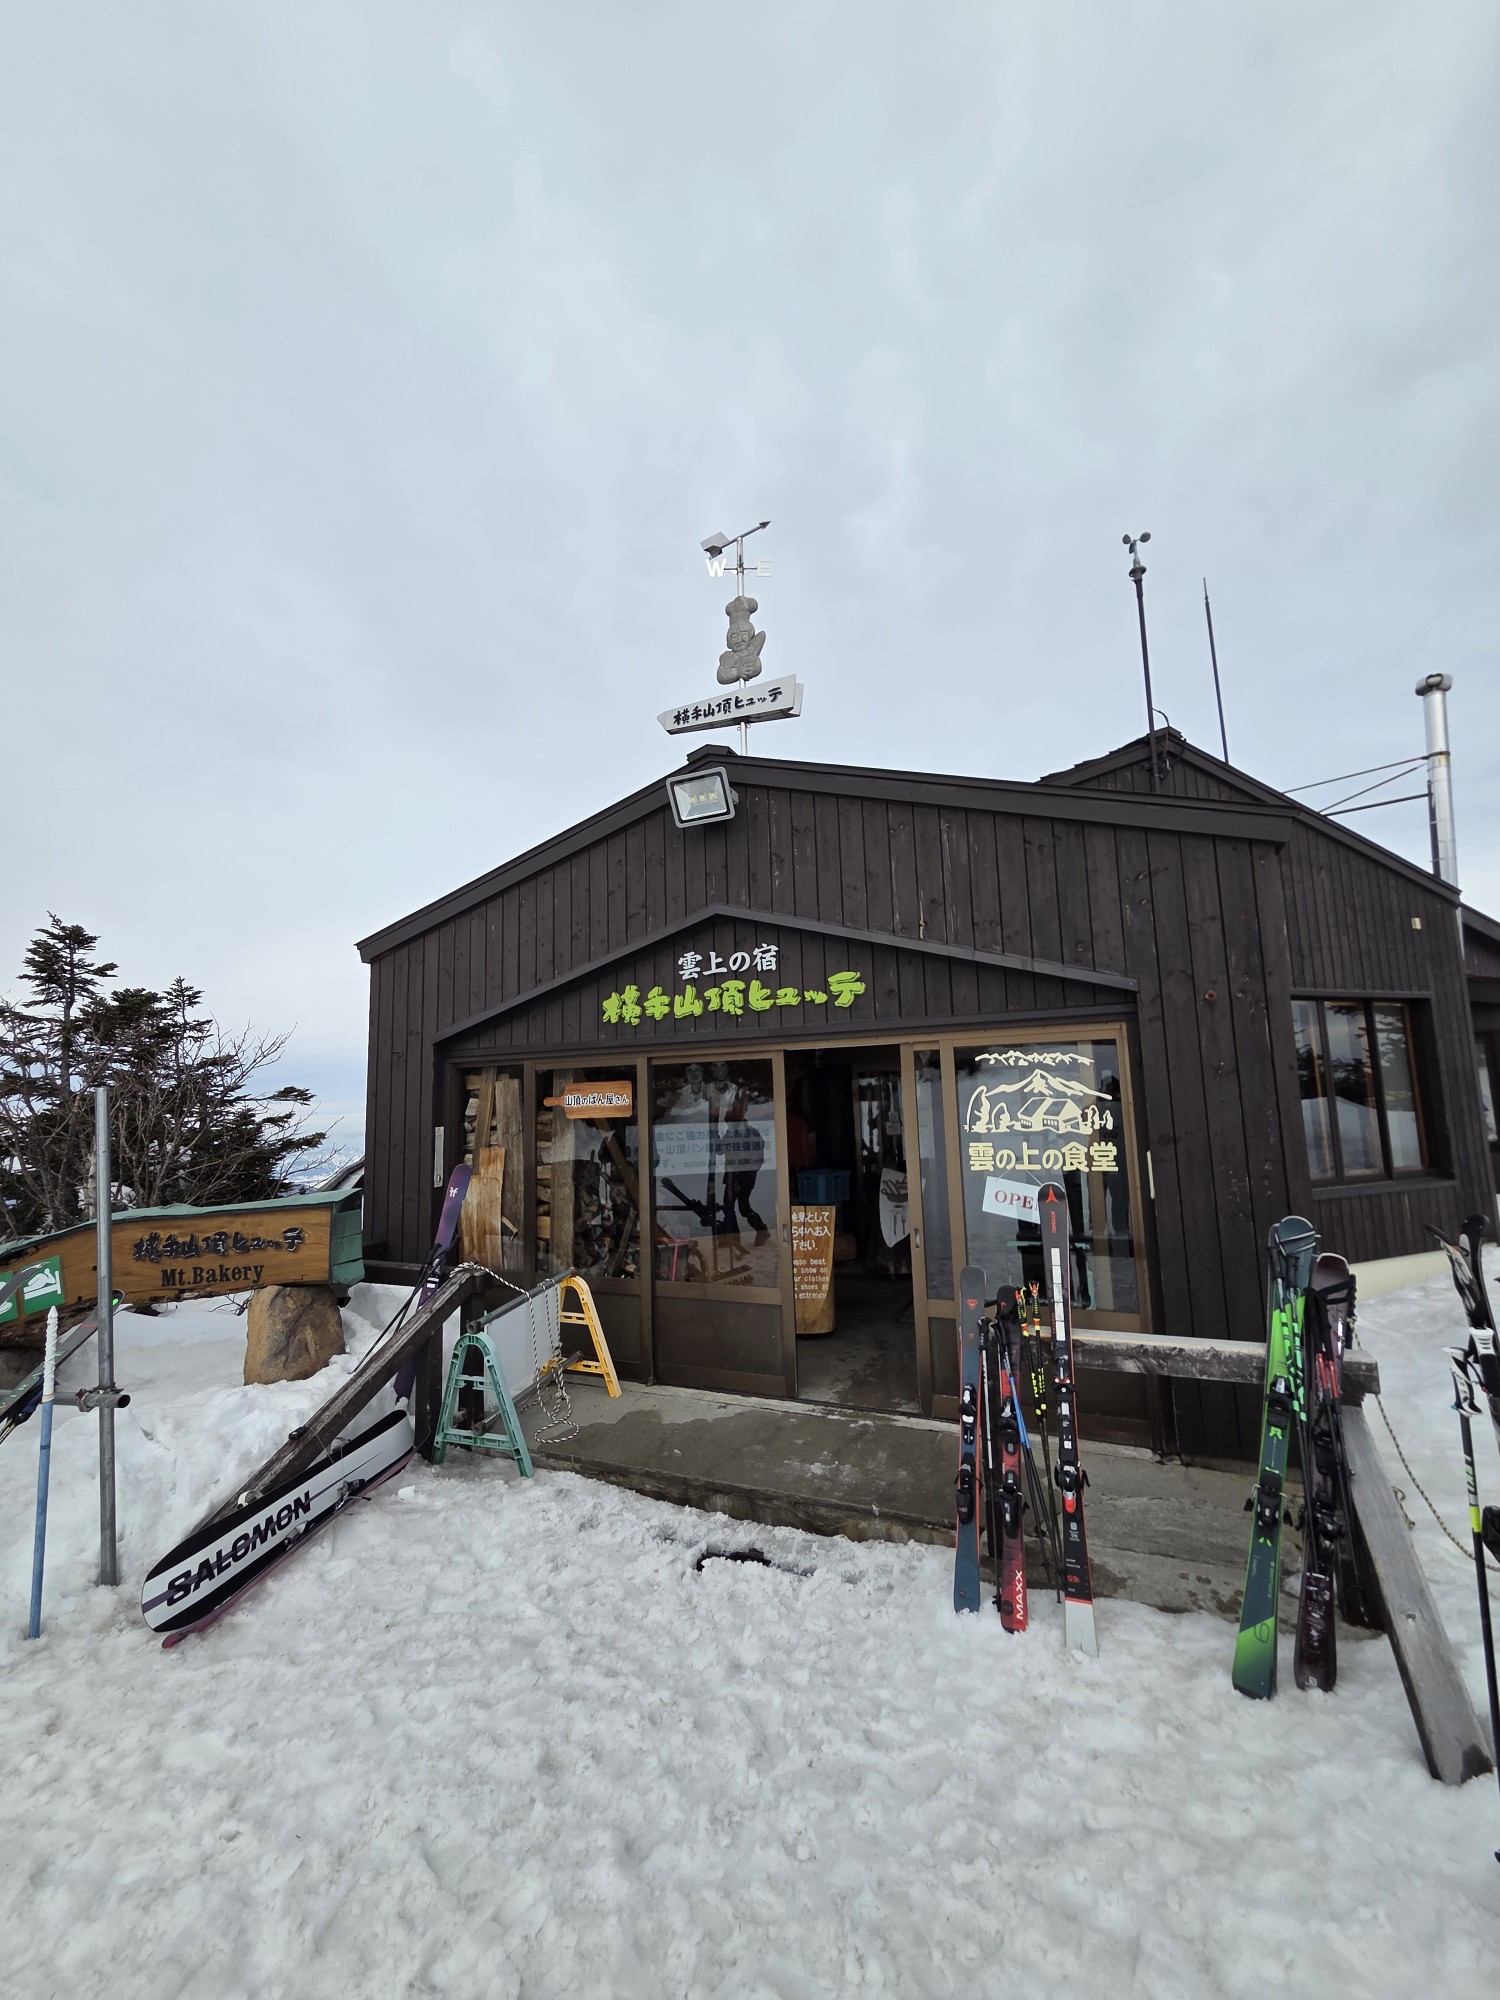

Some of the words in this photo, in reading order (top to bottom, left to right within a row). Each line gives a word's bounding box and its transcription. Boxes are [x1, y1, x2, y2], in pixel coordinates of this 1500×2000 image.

[705, 558, 727, 577] W
[757, 560, 771, 577] E
[673, 687, 782, 725] 横手山頂ヒュッテ
[677, 943, 779, 980] 雲上の宿
[602, 971, 866, 1026] 横手山頂ヒュッテ
[968, 1141, 1119, 1172] 雲の上の食堂
[994, 1189, 1038, 1211] OPE
[132, 1227, 306, 1263] 横手山頂ヒュッテ
[810, 1257, 826, 1266] beat
[161, 1264, 264, 1288] Mt.Bakery
[167, 1490, 311, 1606] SALOMON
